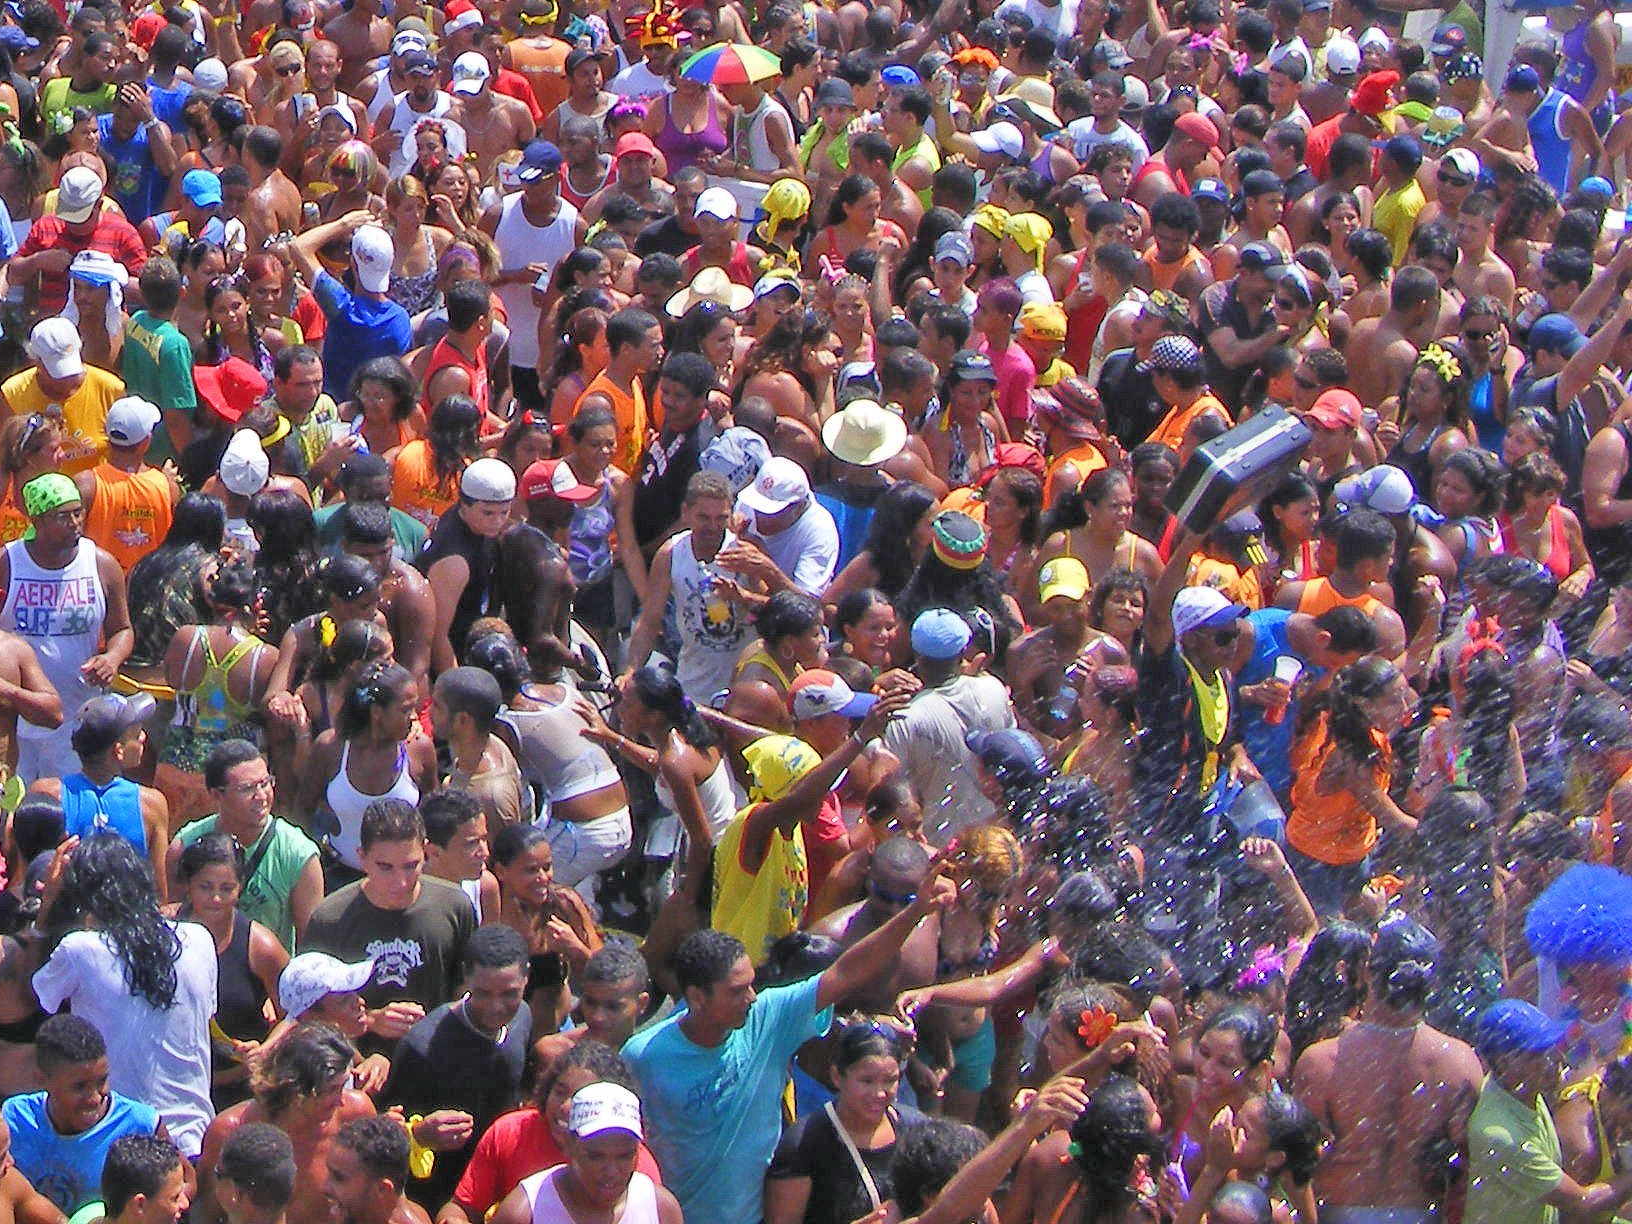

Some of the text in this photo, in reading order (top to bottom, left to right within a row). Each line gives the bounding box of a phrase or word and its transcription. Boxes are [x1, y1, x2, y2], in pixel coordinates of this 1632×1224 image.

[13, 580, 87, 612] AERIAL
[14, 607, 96, 633] SURF 360
